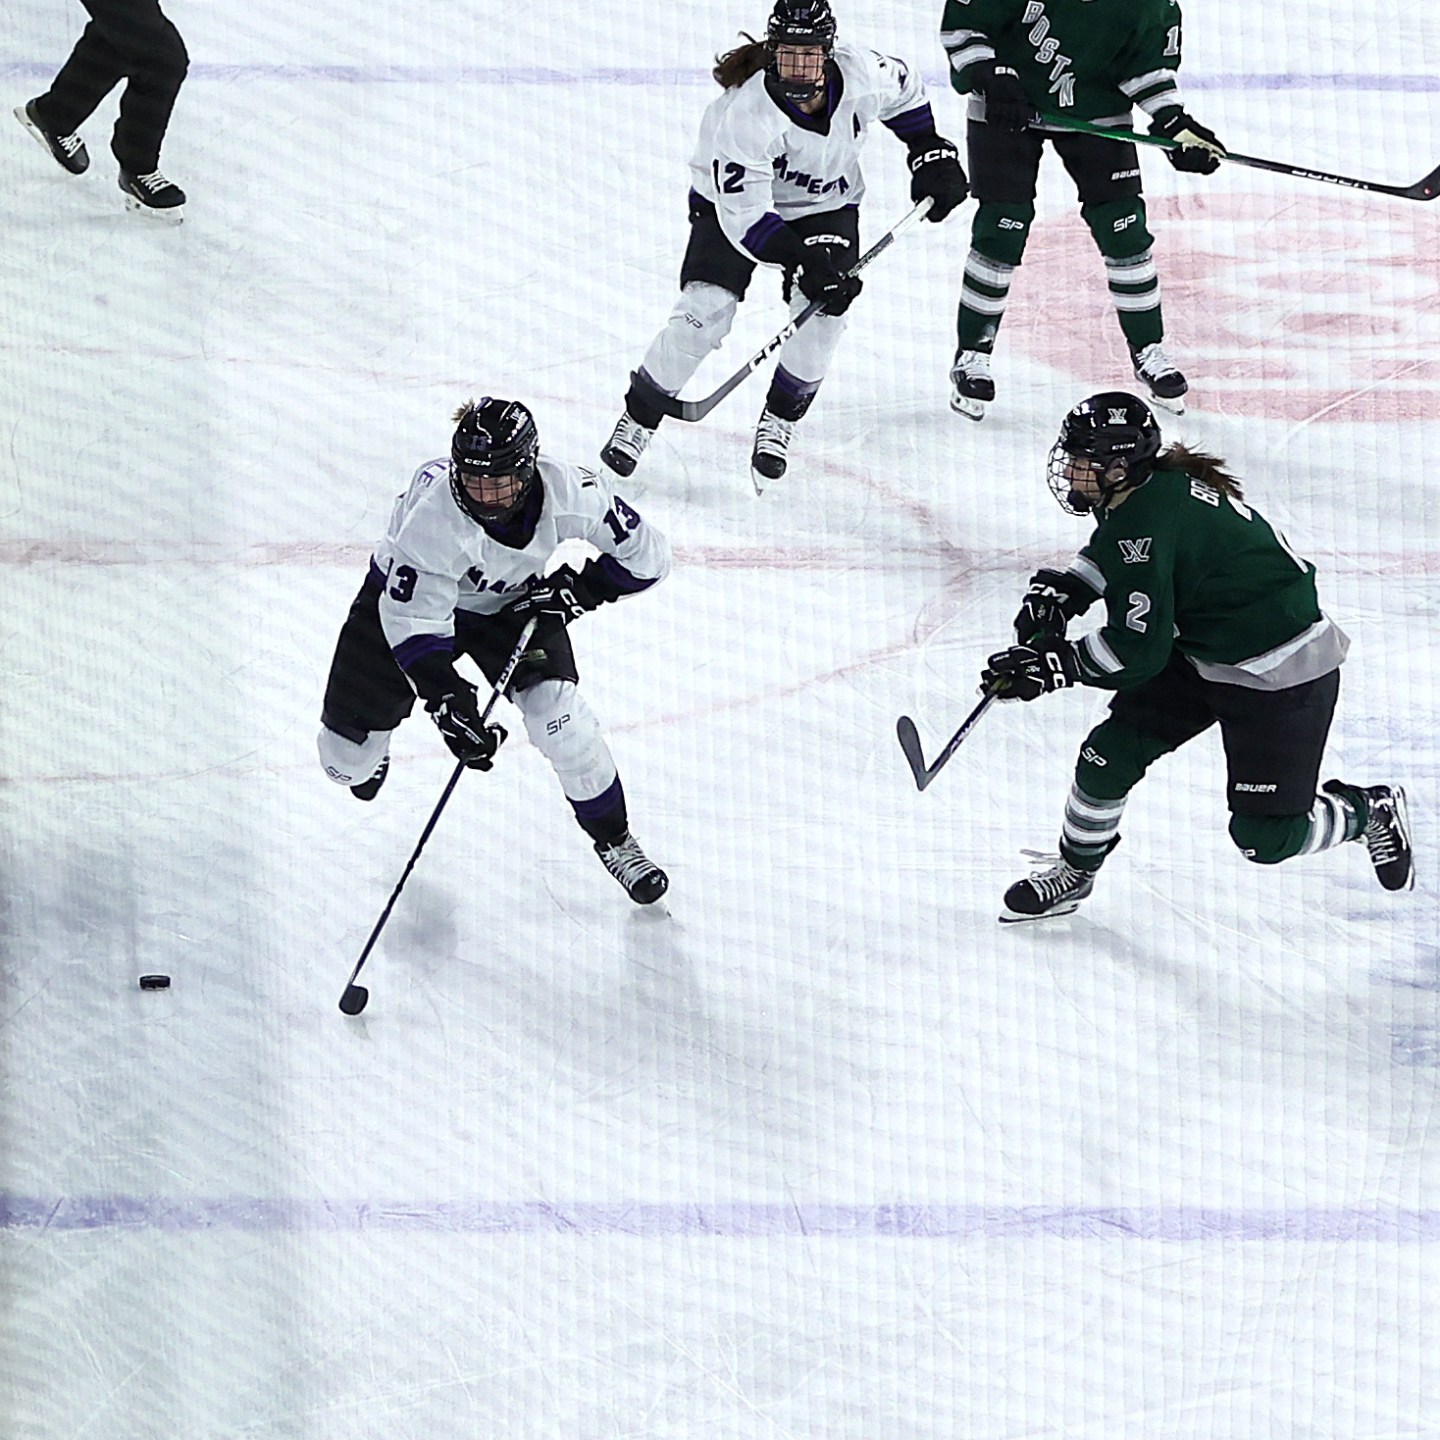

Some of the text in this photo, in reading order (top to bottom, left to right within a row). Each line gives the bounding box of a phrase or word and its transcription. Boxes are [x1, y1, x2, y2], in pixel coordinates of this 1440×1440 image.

[911, 148, 959, 172] CCM
[998, 217, 1025, 231] SP
[1113, 213, 1139, 232] SP
[803, 233, 851, 249] CCM
[747, 321, 800, 373] CCM
[464, 456, 491, 467] CCM
[602, 494, 641, 547] 13
[1125, 591, 1151, 634] 2
[547, 713, 571, 736] SP
[1081, 746, 1108, 768] SP
[1234, 782, 1278, 793] BAUER
